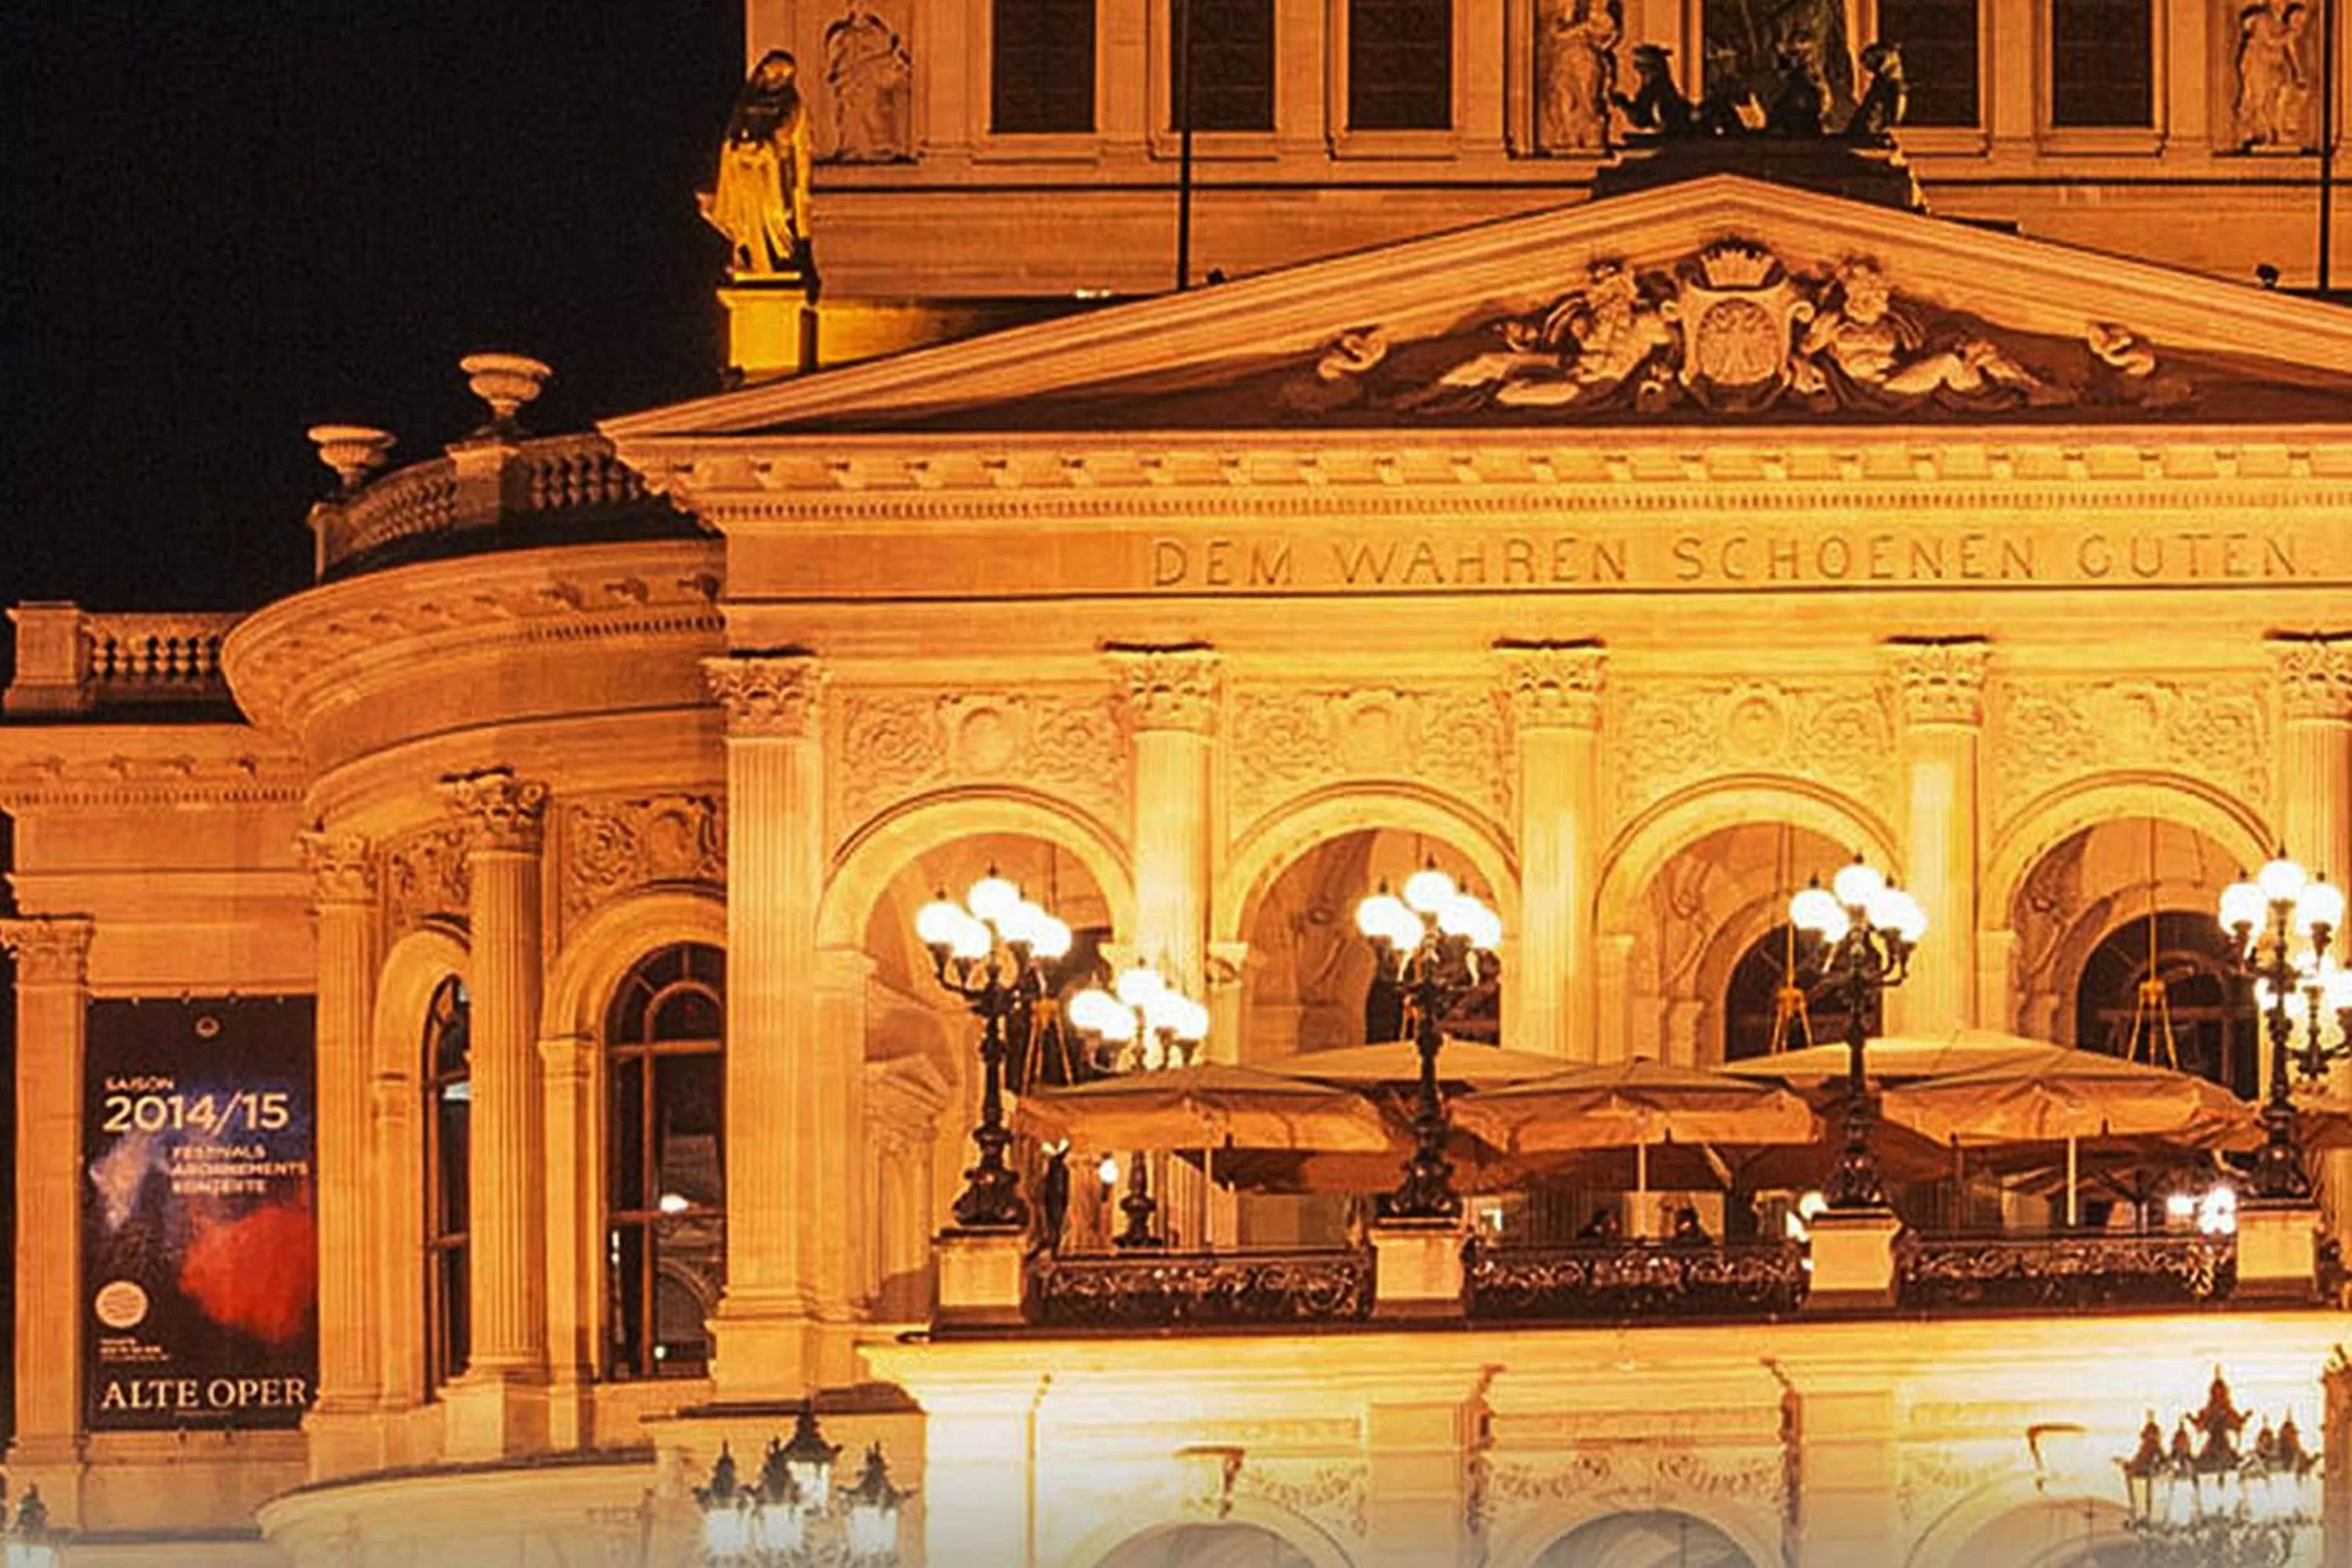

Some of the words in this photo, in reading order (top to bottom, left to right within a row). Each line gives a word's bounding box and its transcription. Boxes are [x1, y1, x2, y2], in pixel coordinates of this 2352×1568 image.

[1153, 540, 1293, 586] DEM
[1332, 537, 1627, 584] WAHREN
[1671, 535, 2036, 581] SCHOENEN
[103, 1091, 289, 1136] 2014/15
[101, 1380, 199, 1409] ALTE
[206, 1377, 307, 1408] OPER
